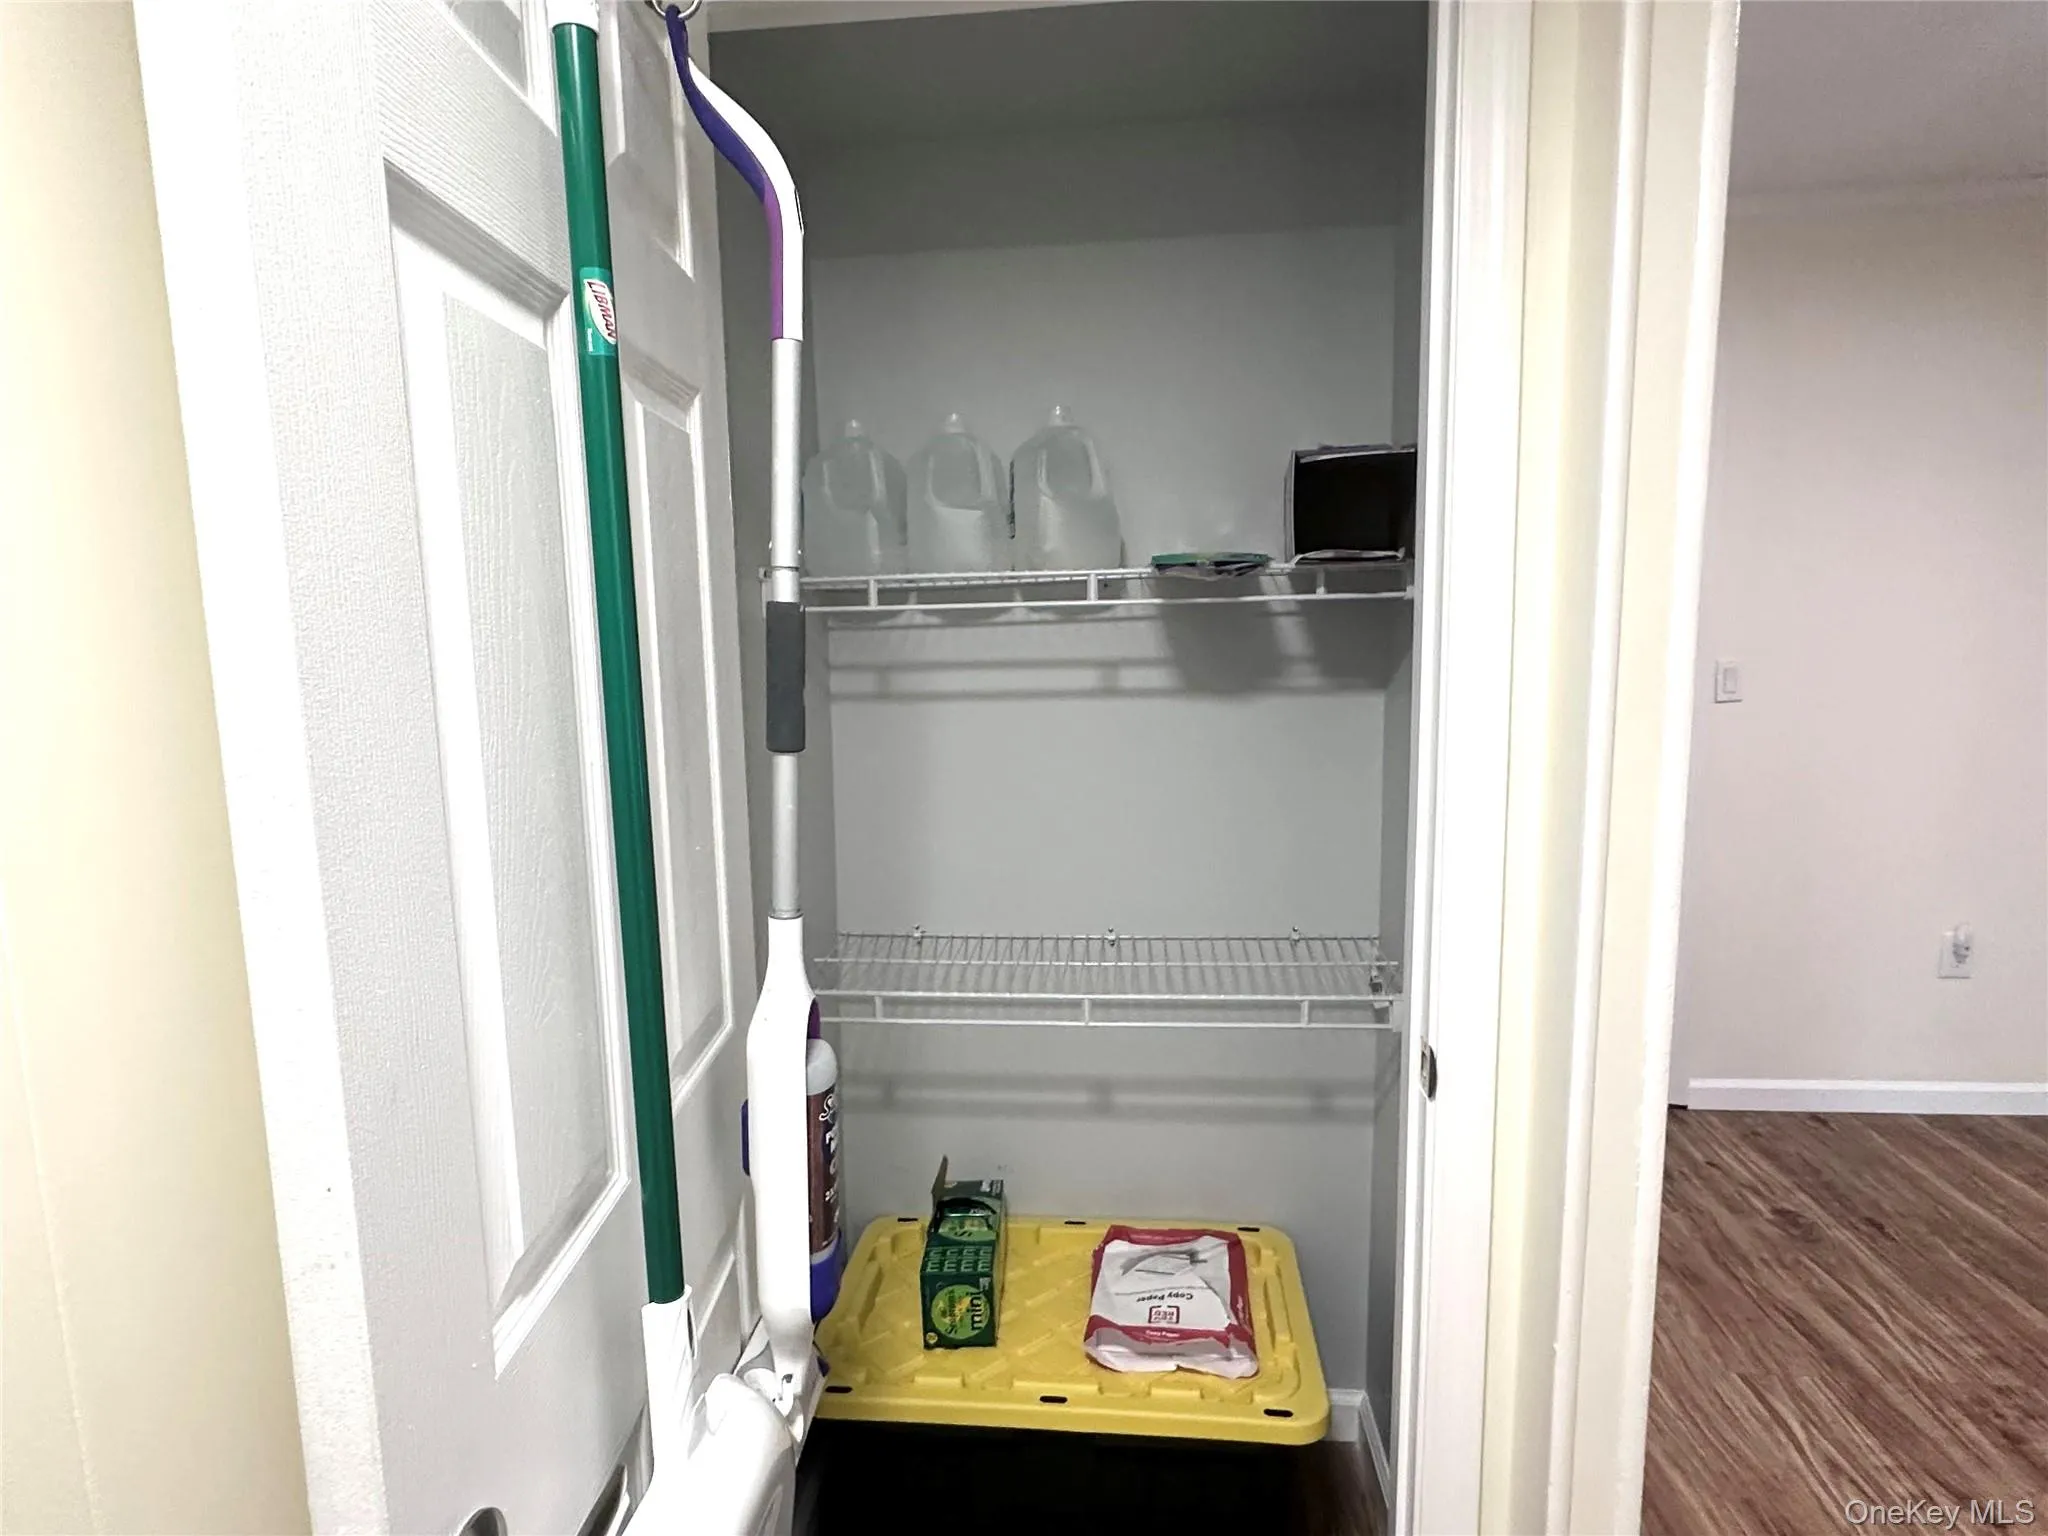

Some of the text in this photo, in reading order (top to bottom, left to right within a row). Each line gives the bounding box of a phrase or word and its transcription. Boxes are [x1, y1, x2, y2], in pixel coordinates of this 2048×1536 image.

[587, 281, 617, 340] LIBMAN
[966, 1291, 983, 1331] mini
[1136, 1292, 1193, 1302] Copy Paper
